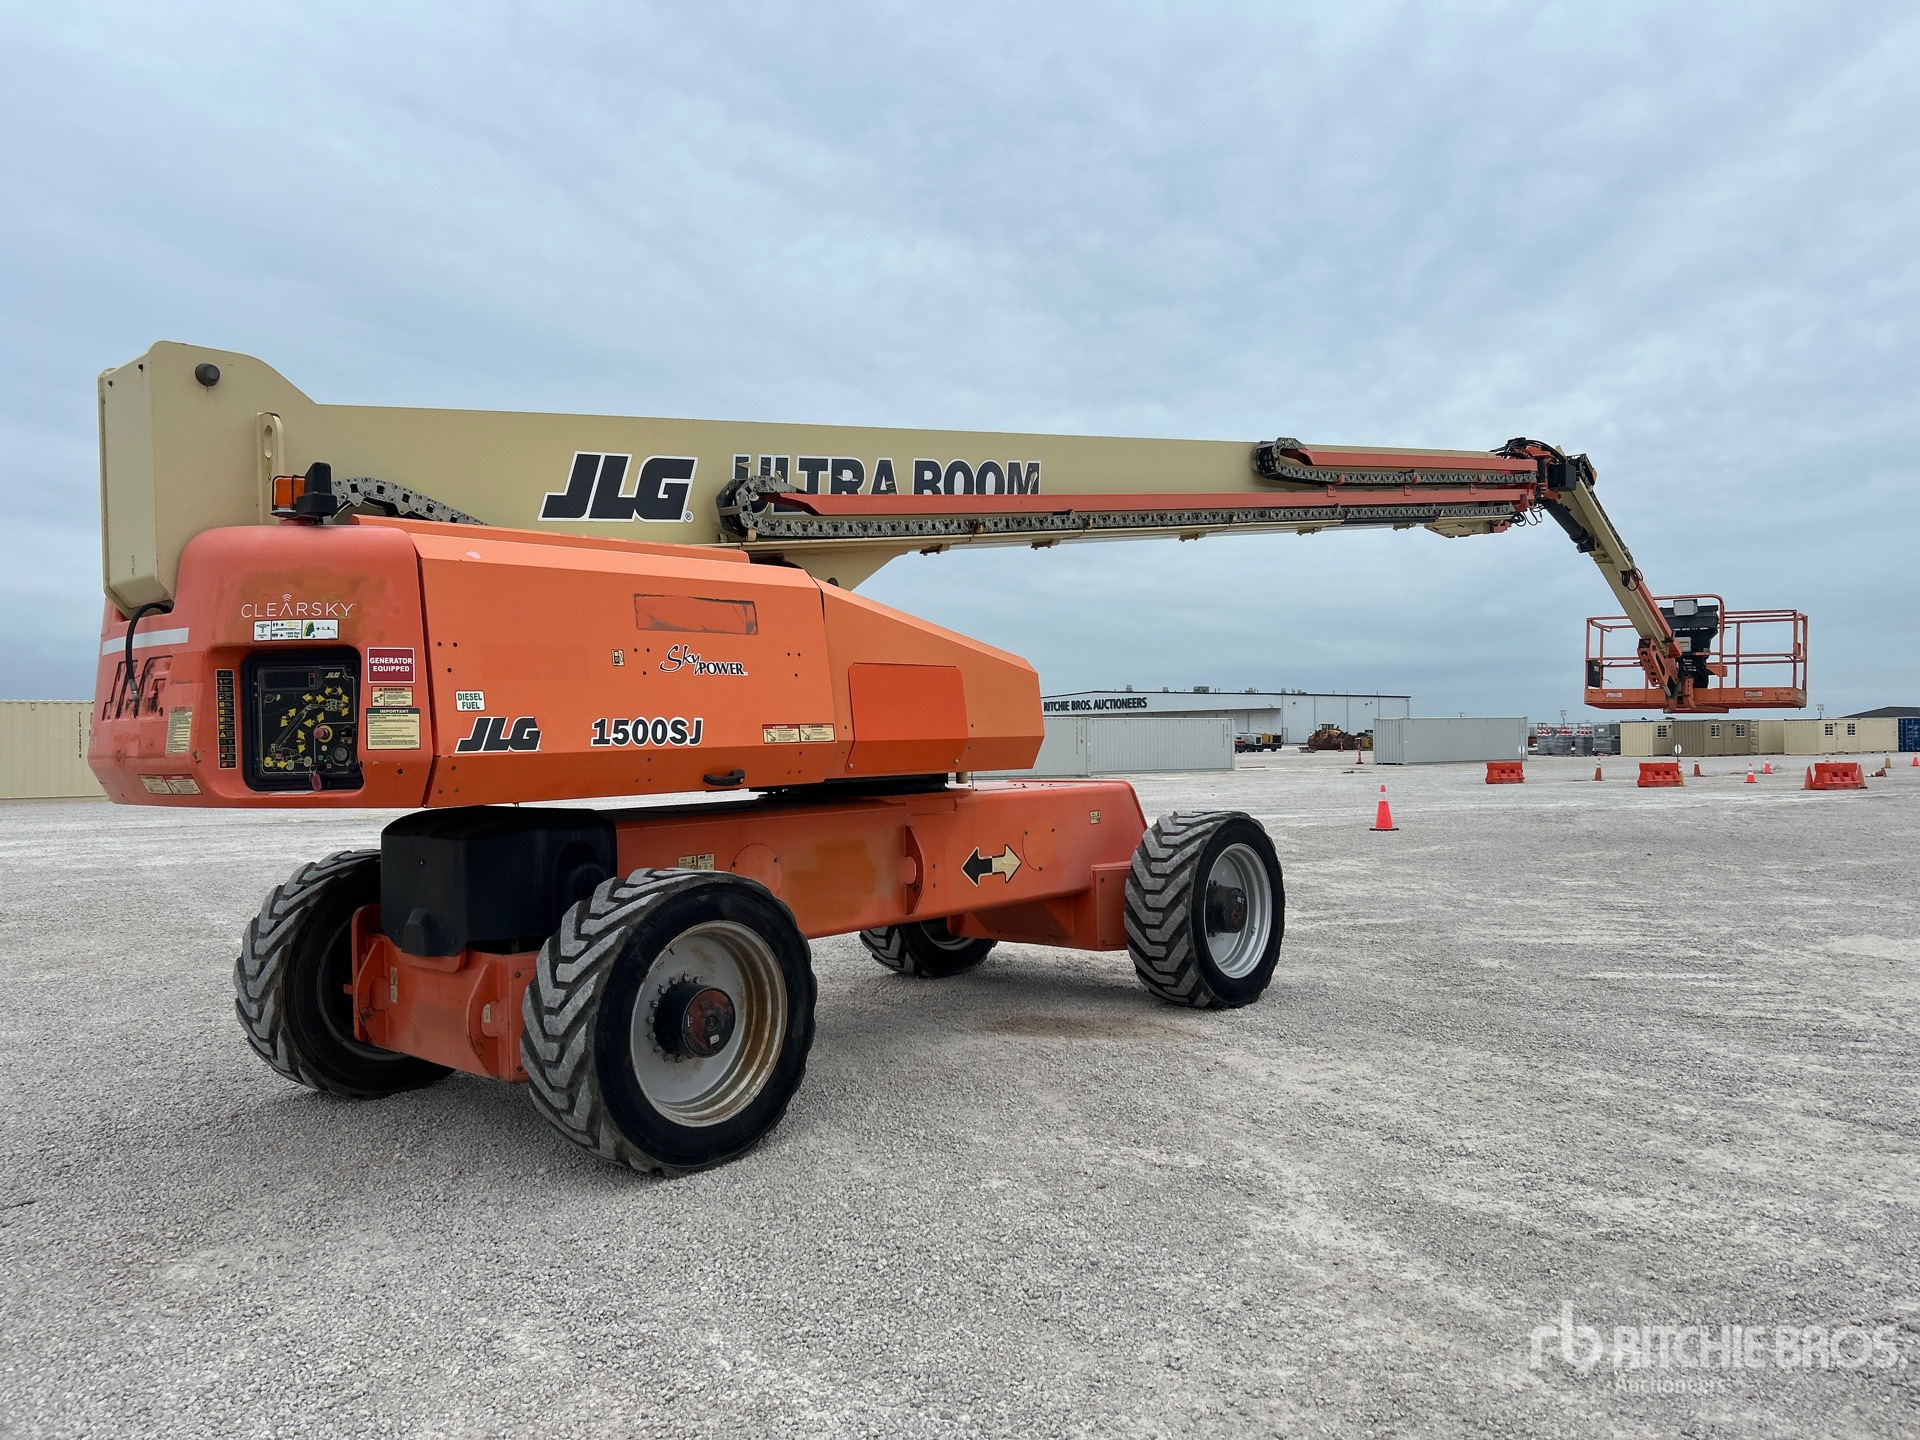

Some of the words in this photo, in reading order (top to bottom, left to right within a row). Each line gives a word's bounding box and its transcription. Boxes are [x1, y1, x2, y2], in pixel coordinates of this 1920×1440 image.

[538, 451, 698, 522] JLG
[912, 458, 1041, 496] BOOM
[241, 602, 353, 618] CLEARSKY
[659, 644, 700, 675] Sky
[698, 661, 745, 676] POWER
[457, 692, 483, 701] DIESEL
[461, 701, 480, 710] FUEL
[1043, 701, 1070, 712] RITCHIE
[1071, 700, 1092, 711] BROS.
[1093, 697, 1148, 710] AUCTIONEERS
[454, 716, 542, 754] JLG
[590, 716, 704, 747] 1500SJ
